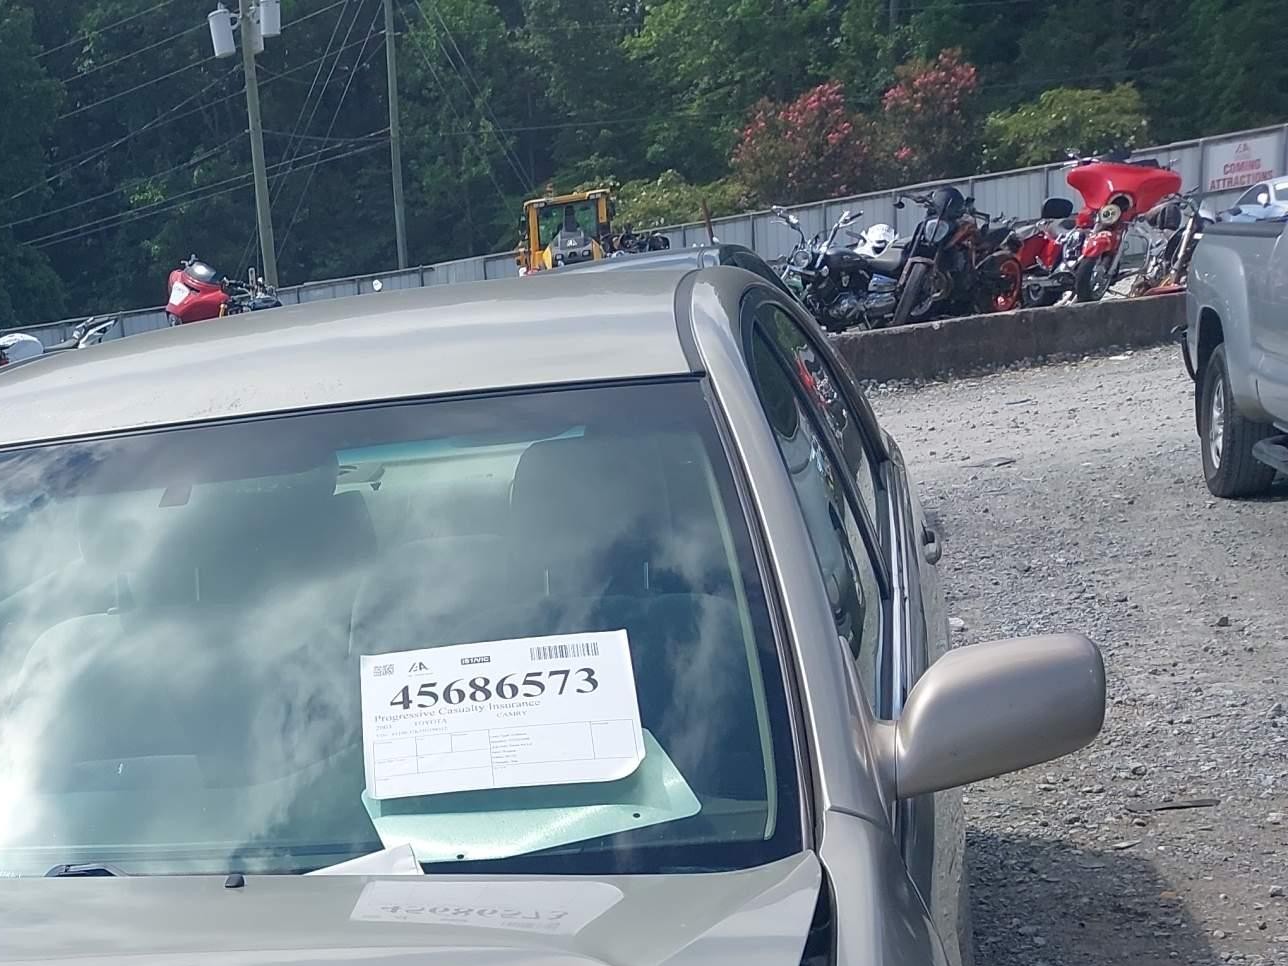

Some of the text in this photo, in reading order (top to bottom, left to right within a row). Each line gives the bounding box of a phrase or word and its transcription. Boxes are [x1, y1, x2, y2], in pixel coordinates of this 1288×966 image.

[1224, 158, 1261, 175] COMING
[1209, 170, 1273, 190] ATTRACTIONS
[390, 667, 599, 710] 45686573
[374, 700, 541, 723] Progressive Casualty Insurance
